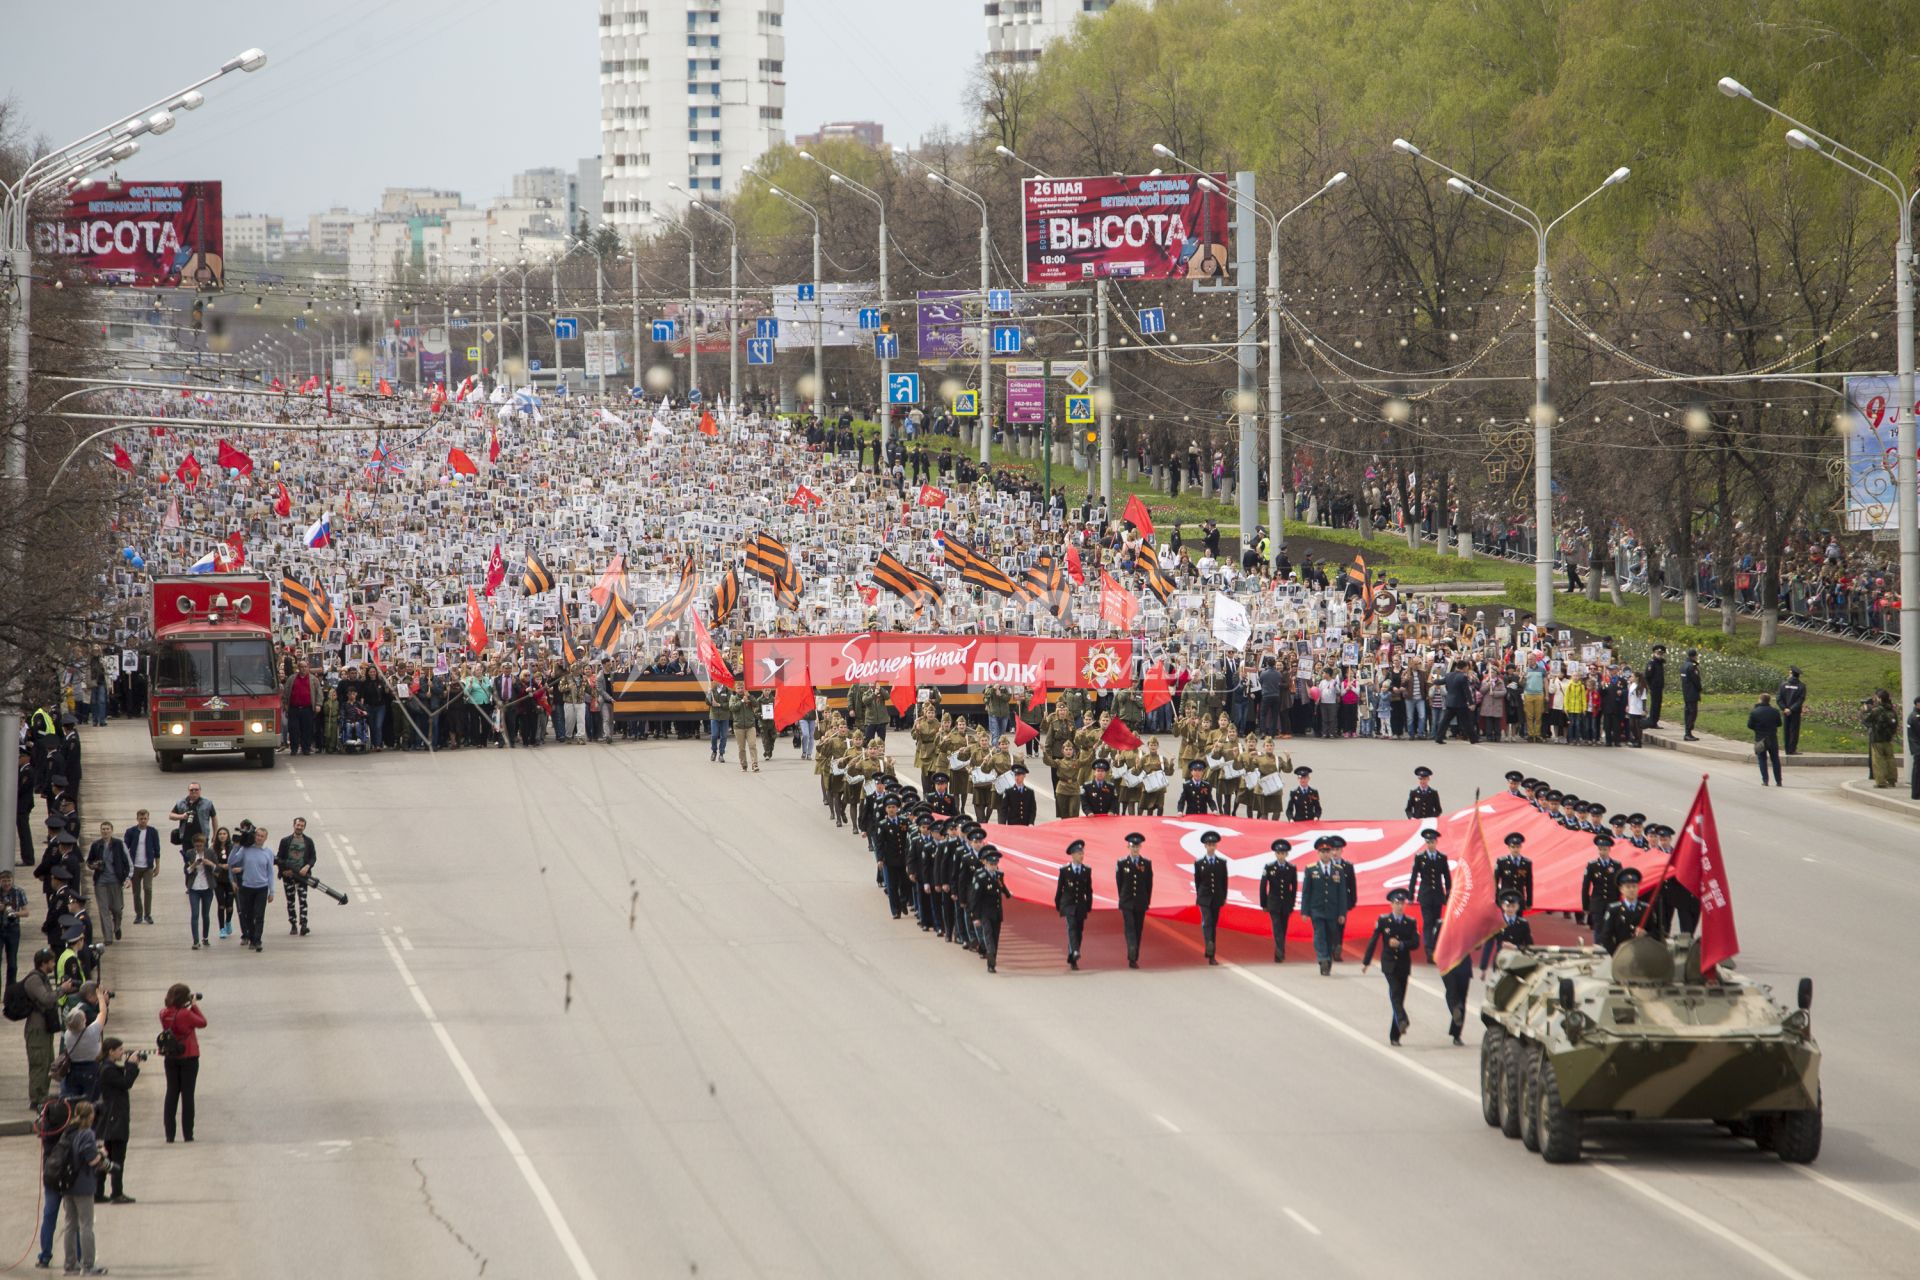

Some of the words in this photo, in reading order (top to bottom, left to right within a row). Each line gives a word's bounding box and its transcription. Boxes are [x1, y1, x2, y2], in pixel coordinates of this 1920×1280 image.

[1034, 182, 1052, 195] 26
[1053, 182, 1083, 194] МАЯ
[1139, 180, 1190, 191] ФЕСТИВАЛЬ
[1101, 192, 1159, 207] ВЕТЕРАНСКОЙ
[34, 220, 181, 254] ВЫСОТА
[1049, 214, 1188, 250] ВЫСОТА
[1040, 255, 1066, 264] 18:00
